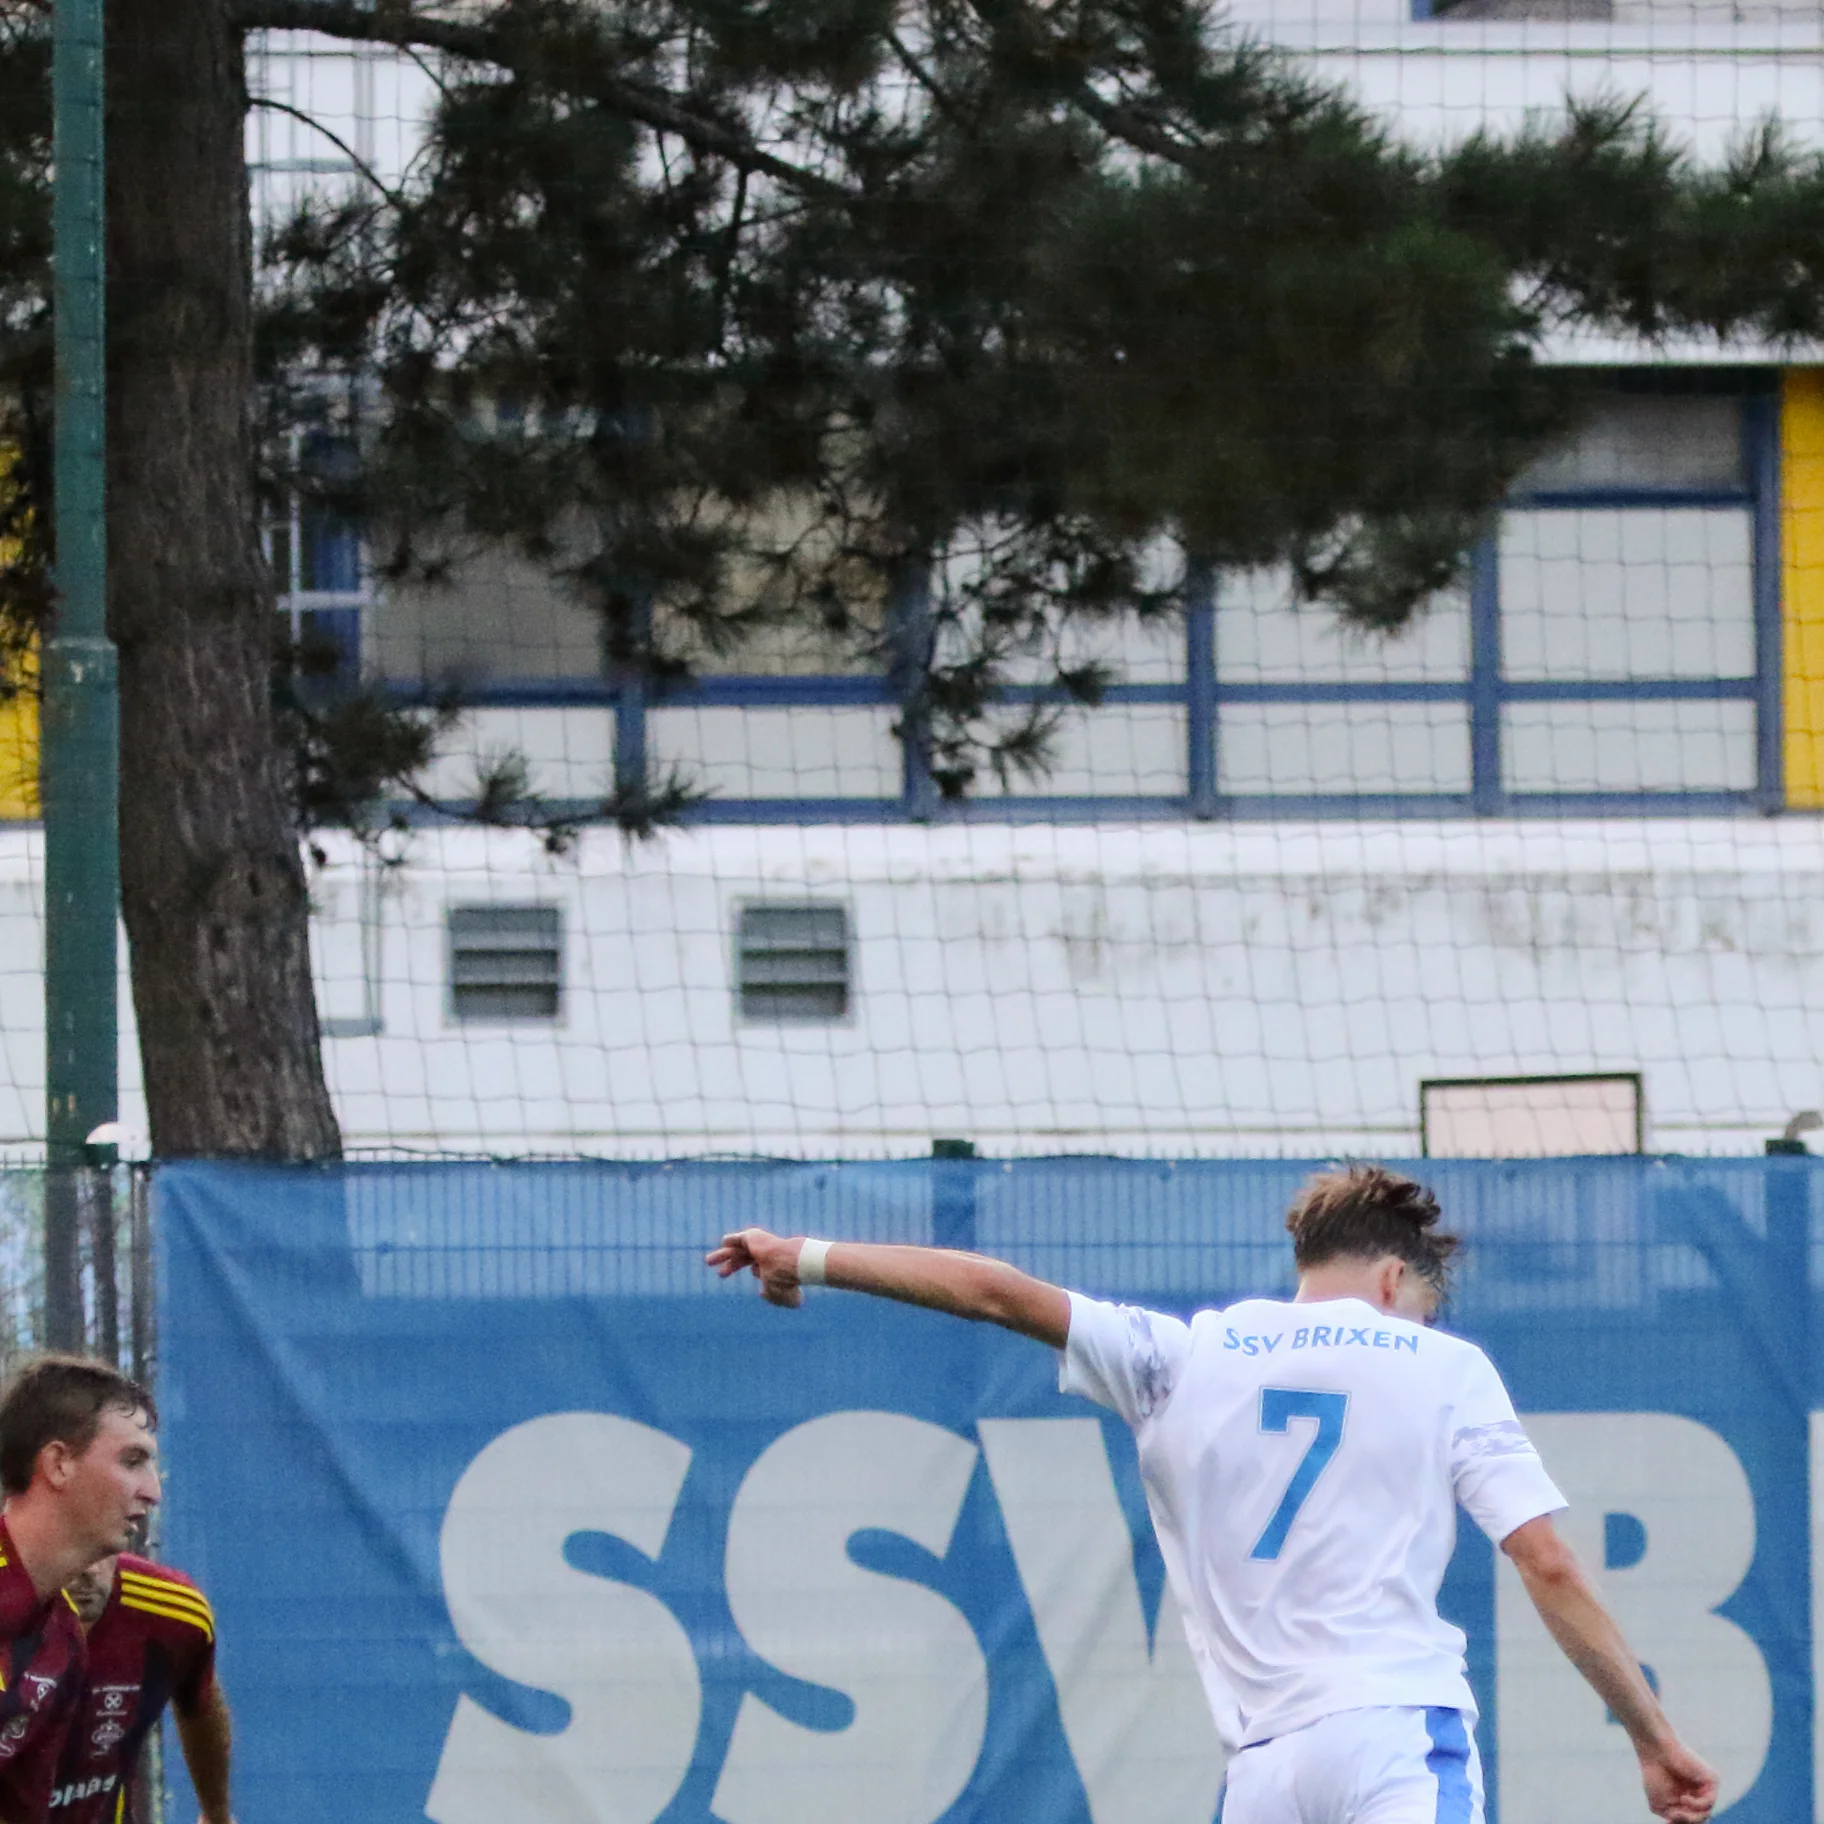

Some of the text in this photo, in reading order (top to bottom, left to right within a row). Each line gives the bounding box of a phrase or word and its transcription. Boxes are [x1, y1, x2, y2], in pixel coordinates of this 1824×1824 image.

[1223, 1326, 1420, 1356] SSV BRIXEN
[1248, 1386, 1352, 1562] 7
